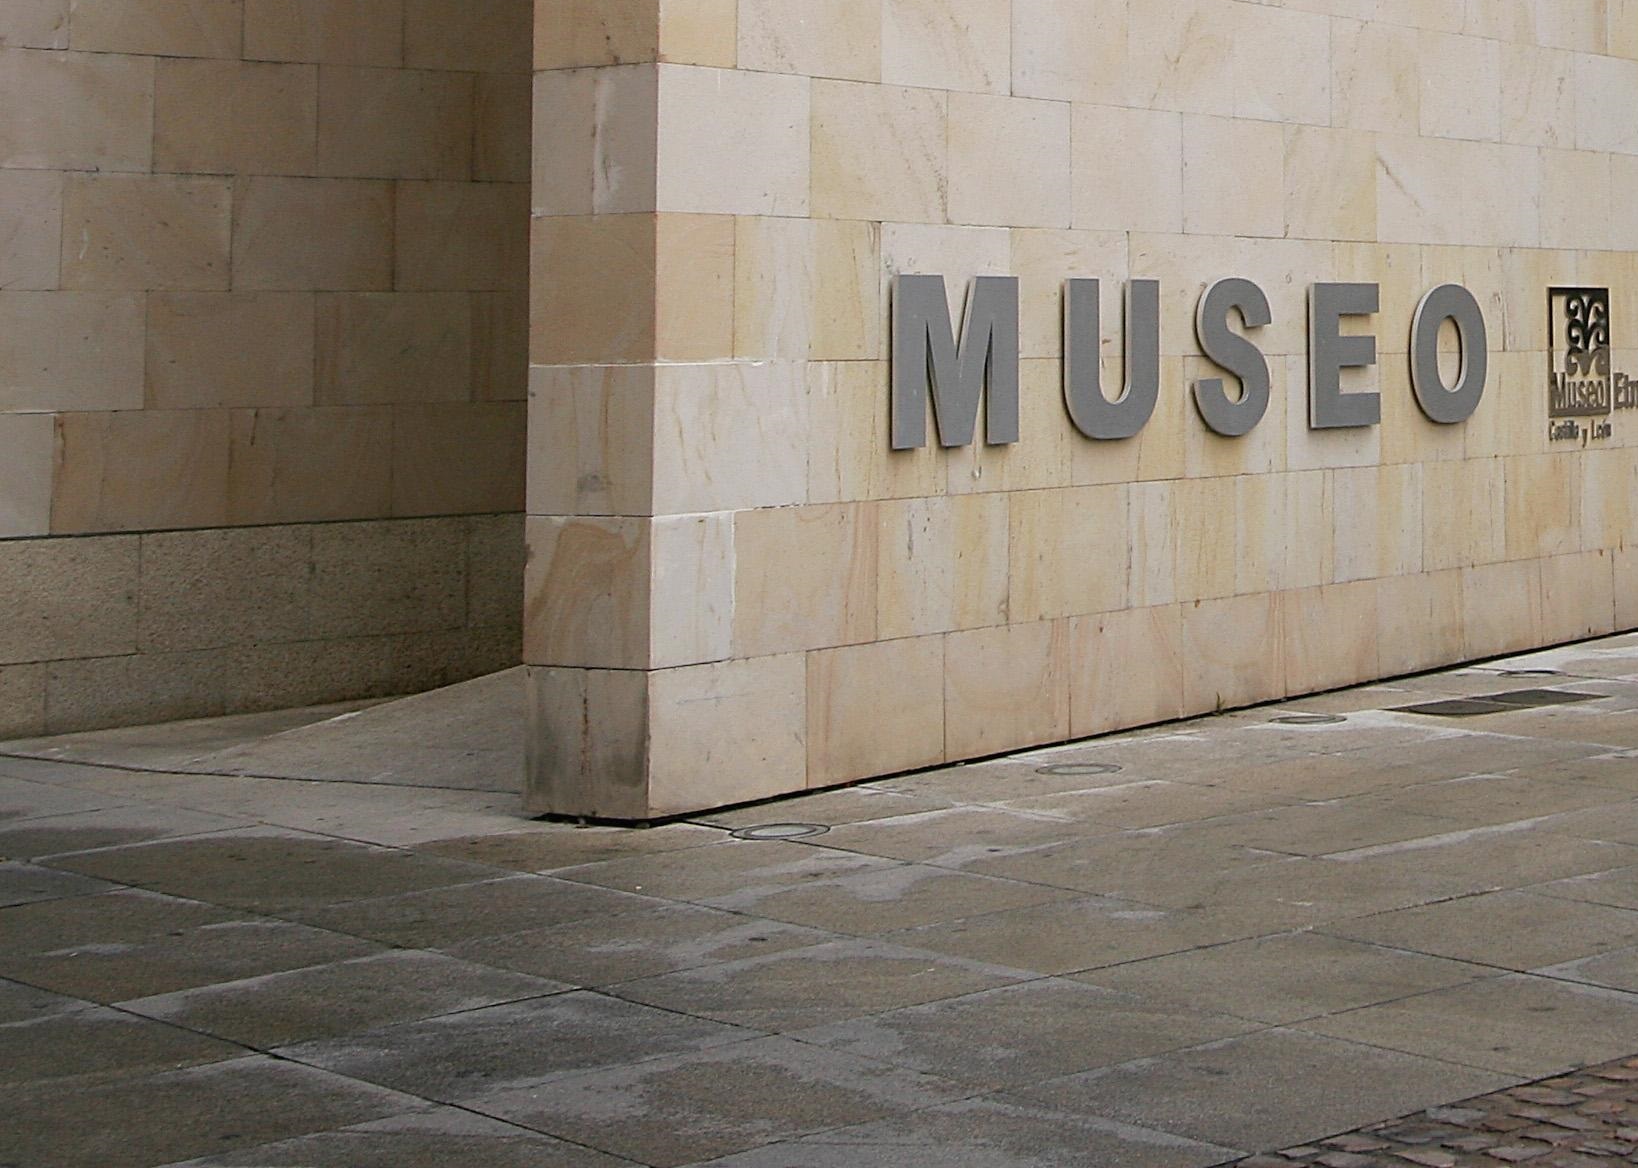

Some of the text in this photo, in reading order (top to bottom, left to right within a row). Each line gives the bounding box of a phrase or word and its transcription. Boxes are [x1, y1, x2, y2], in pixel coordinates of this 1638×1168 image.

[891, 273, 1488, 451] MUSEO
[1550, 372, 1604, 409] Museo
[1580, 427, 1588, 448] y
